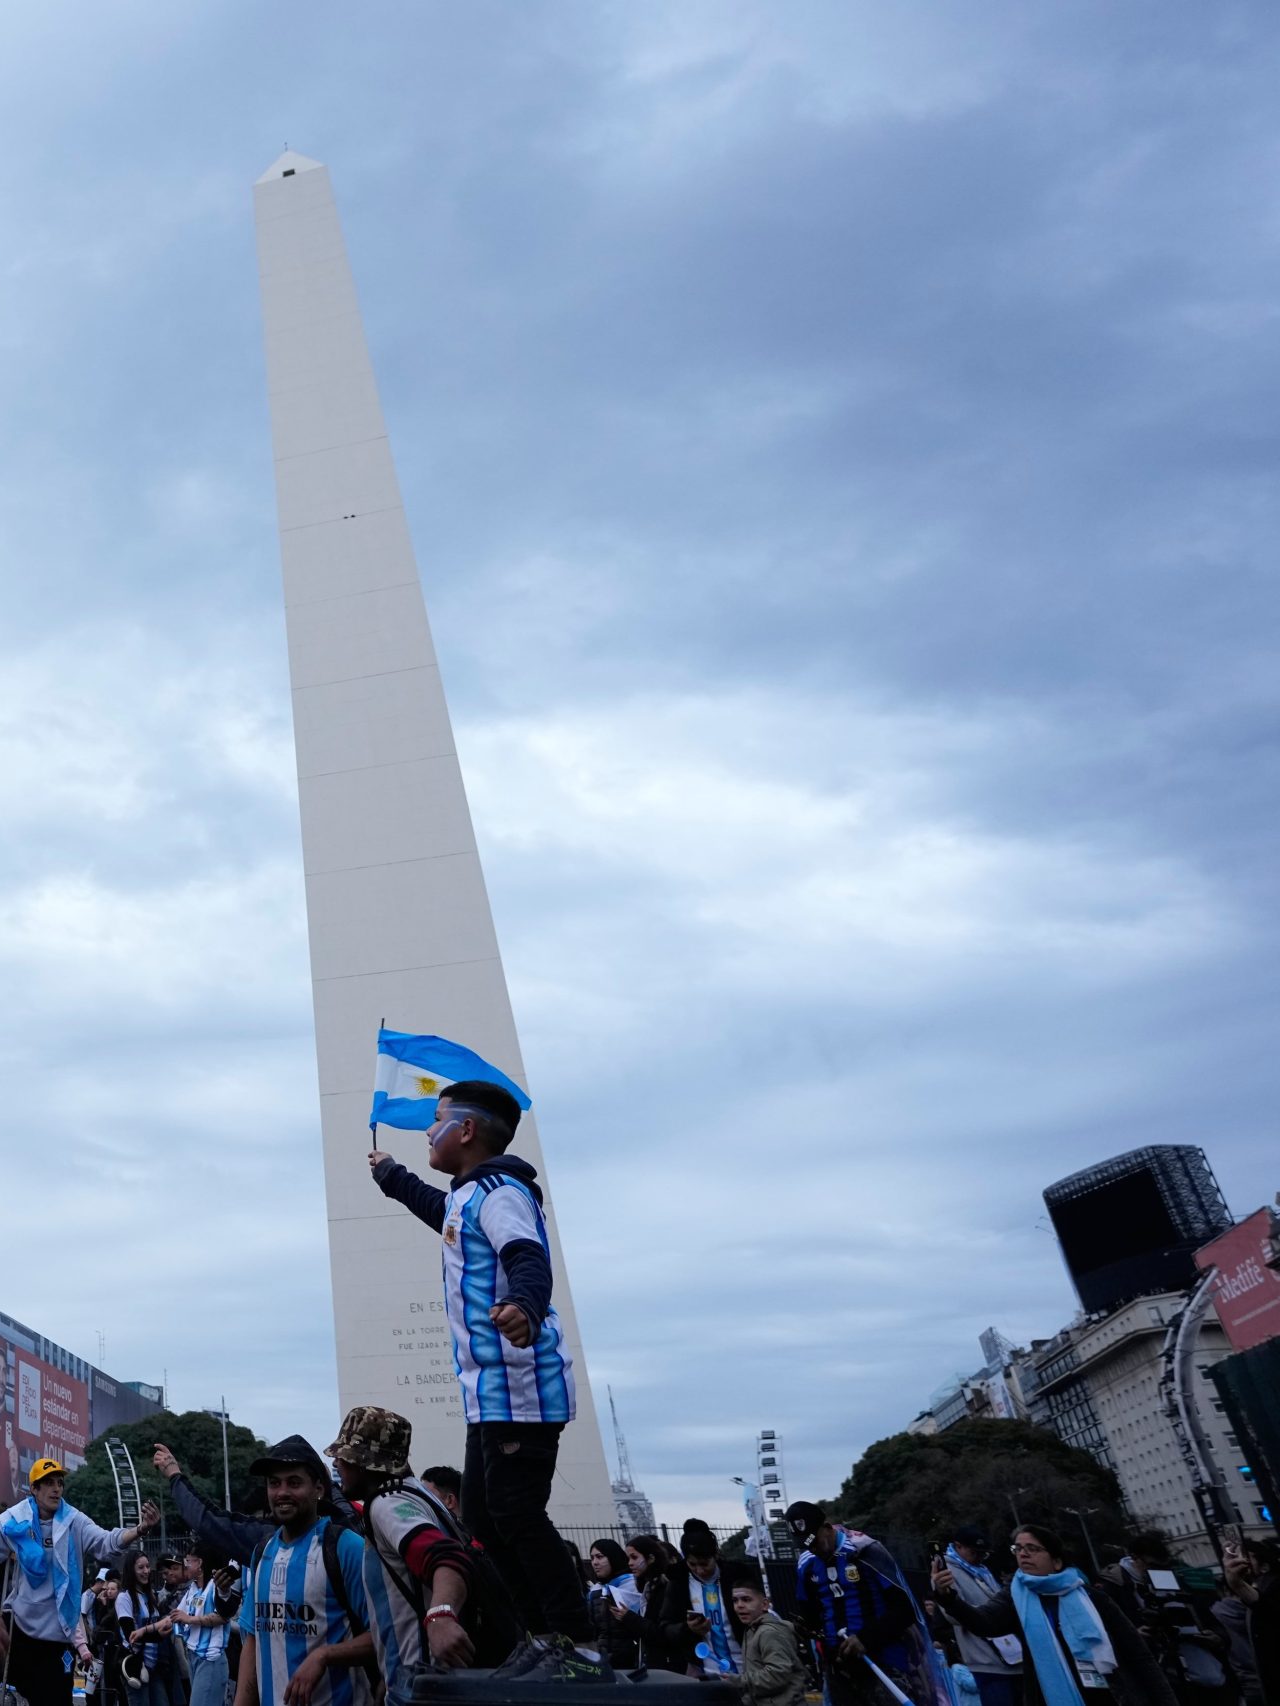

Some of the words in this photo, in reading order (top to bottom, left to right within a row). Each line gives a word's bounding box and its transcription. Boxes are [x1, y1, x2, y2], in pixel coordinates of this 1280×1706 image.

[409, 1303, 424, 1313] EN
[429, 1301, 444, 1312] ES
[406, 1328, 416, 1336] LA
[421, 1326, 445, 1334] TORRE
[43, 1373, 52, 1391] Un
[53, 1381, 72, 1404] nuevo
[95, 1375, 117, 1398] SAMSUNG
[396, 1375, 410, 1386] LA
[449, 1395, 459, 1403] DE
[43, 1397, 70, 1422] estándar
[71, 1412, 79, 1426] en
[43, 1416, 86, 1449] departamentos
[709, 1609, 721, 1626] 10
